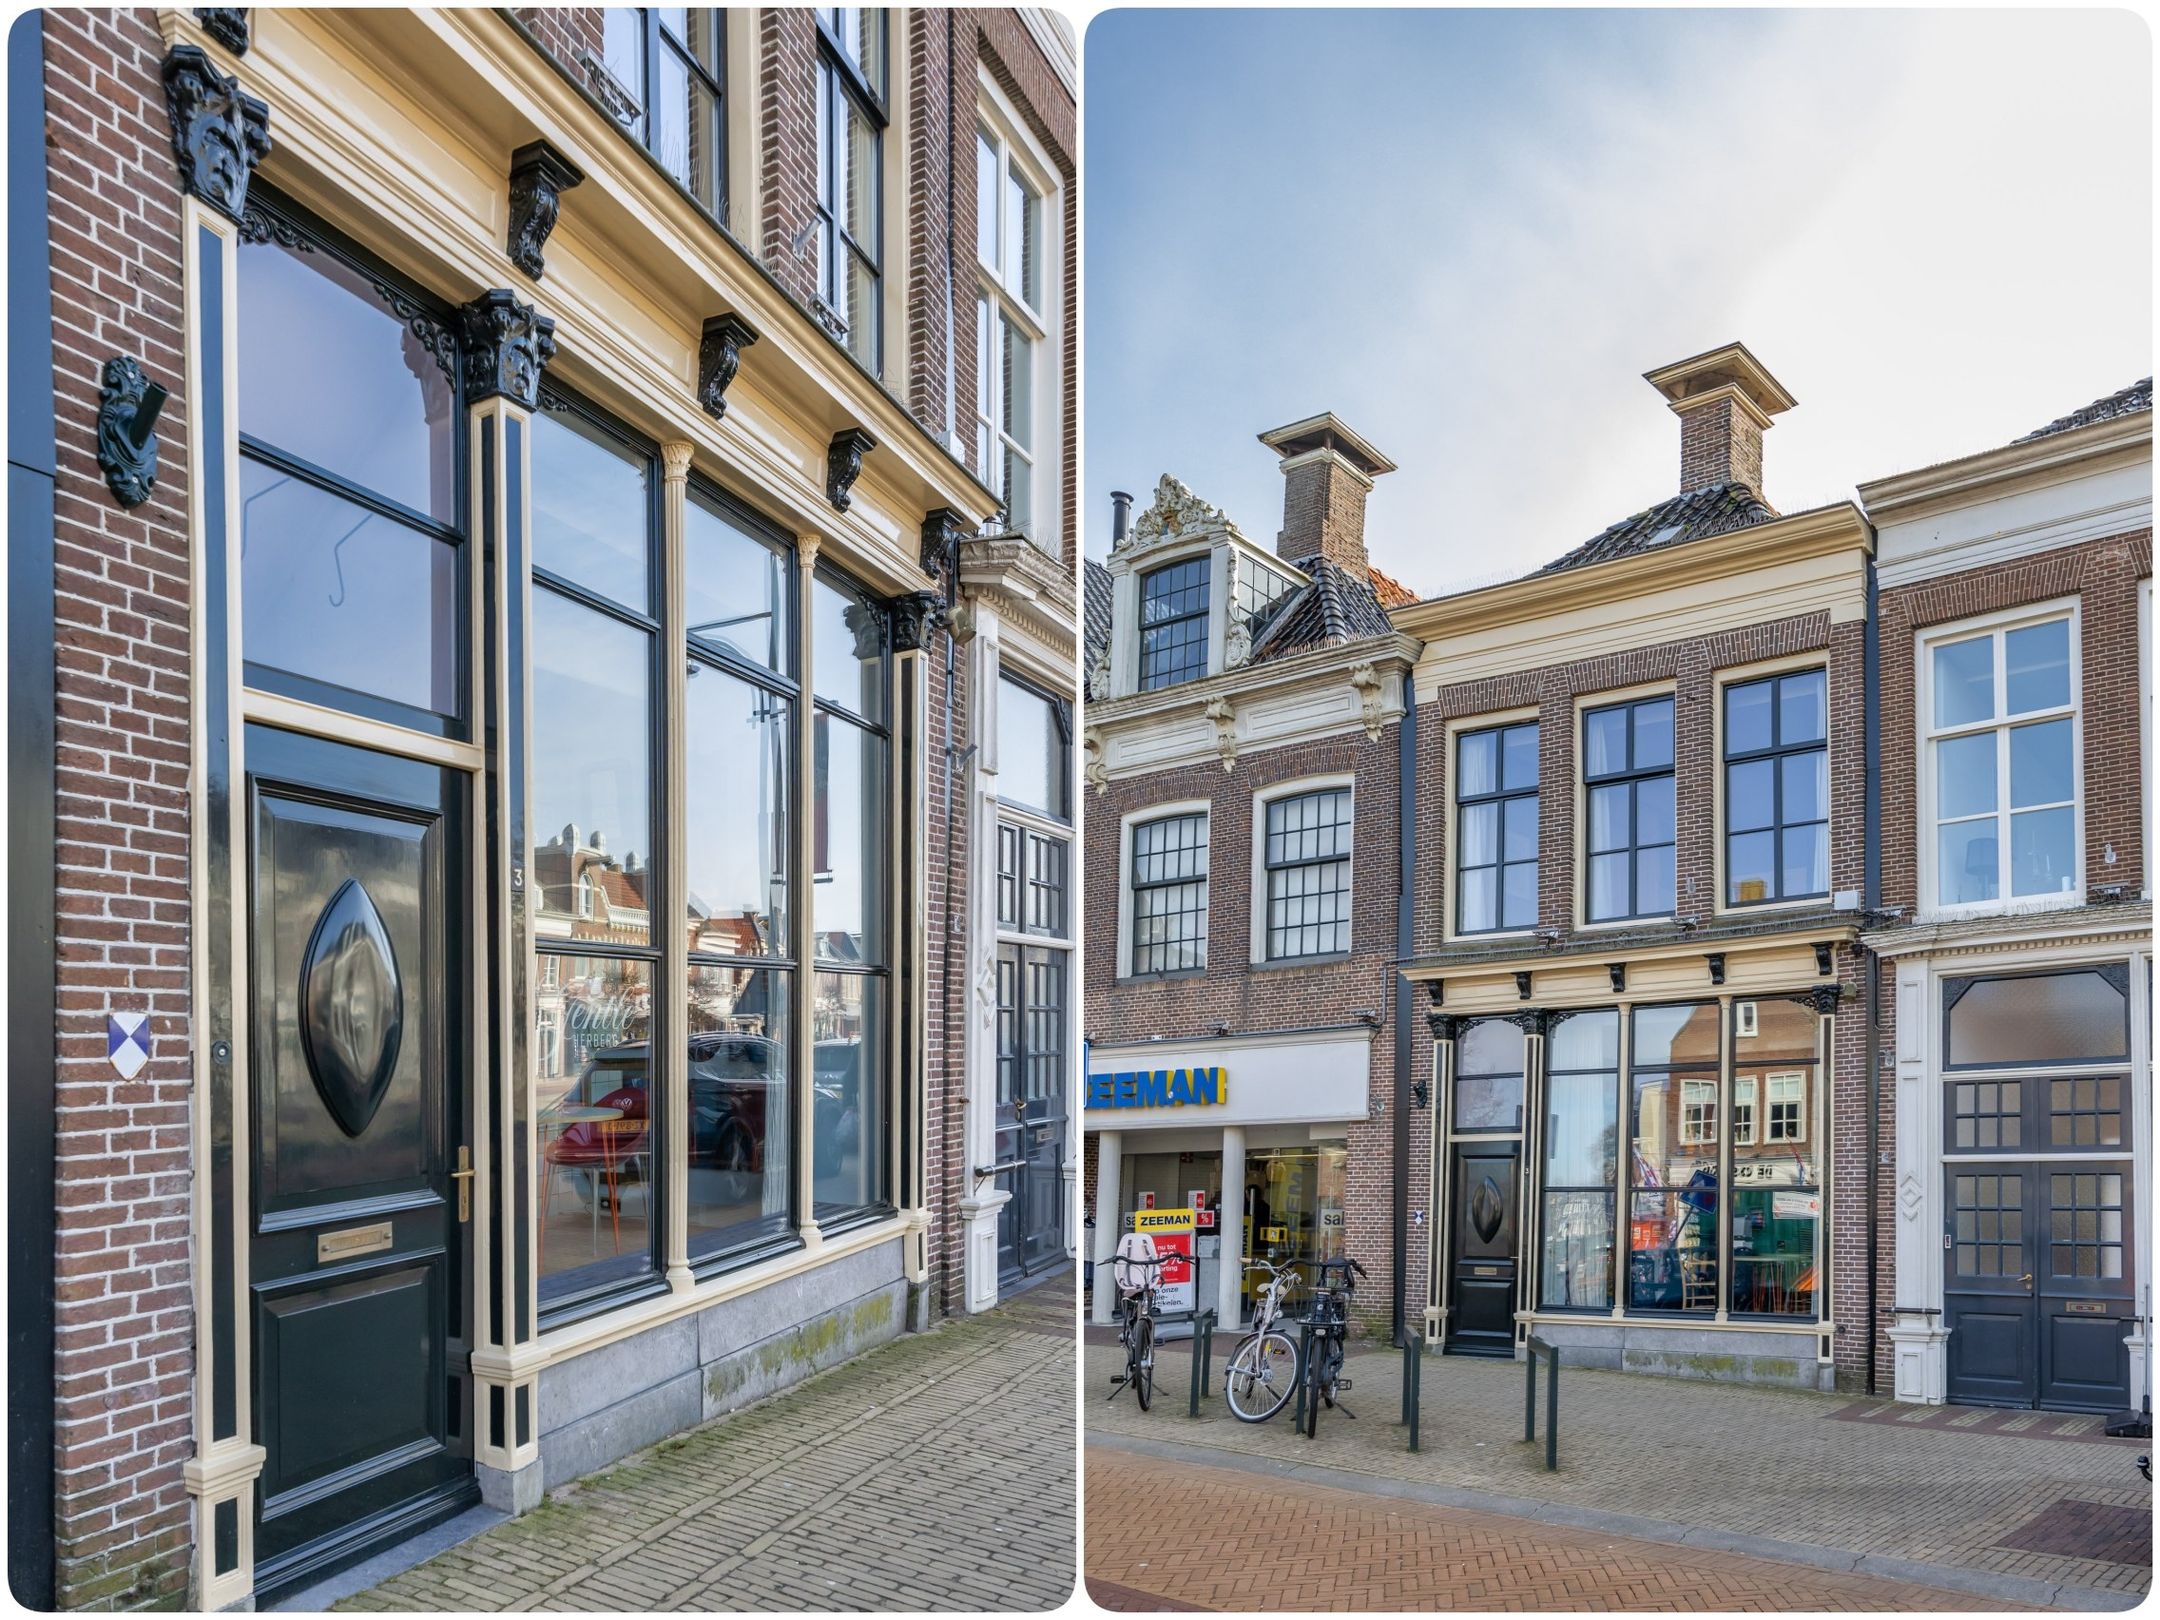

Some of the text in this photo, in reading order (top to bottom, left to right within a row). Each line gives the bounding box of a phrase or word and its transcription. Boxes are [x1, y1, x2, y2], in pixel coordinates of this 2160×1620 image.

[514, 868, 523, 887] 3
[574, 1033, 619, 1048] HERBERG
[1087, 1067, 1226, 1109] EEMAN
[1140, 1215, 1190, 1226] ZEEMAN
